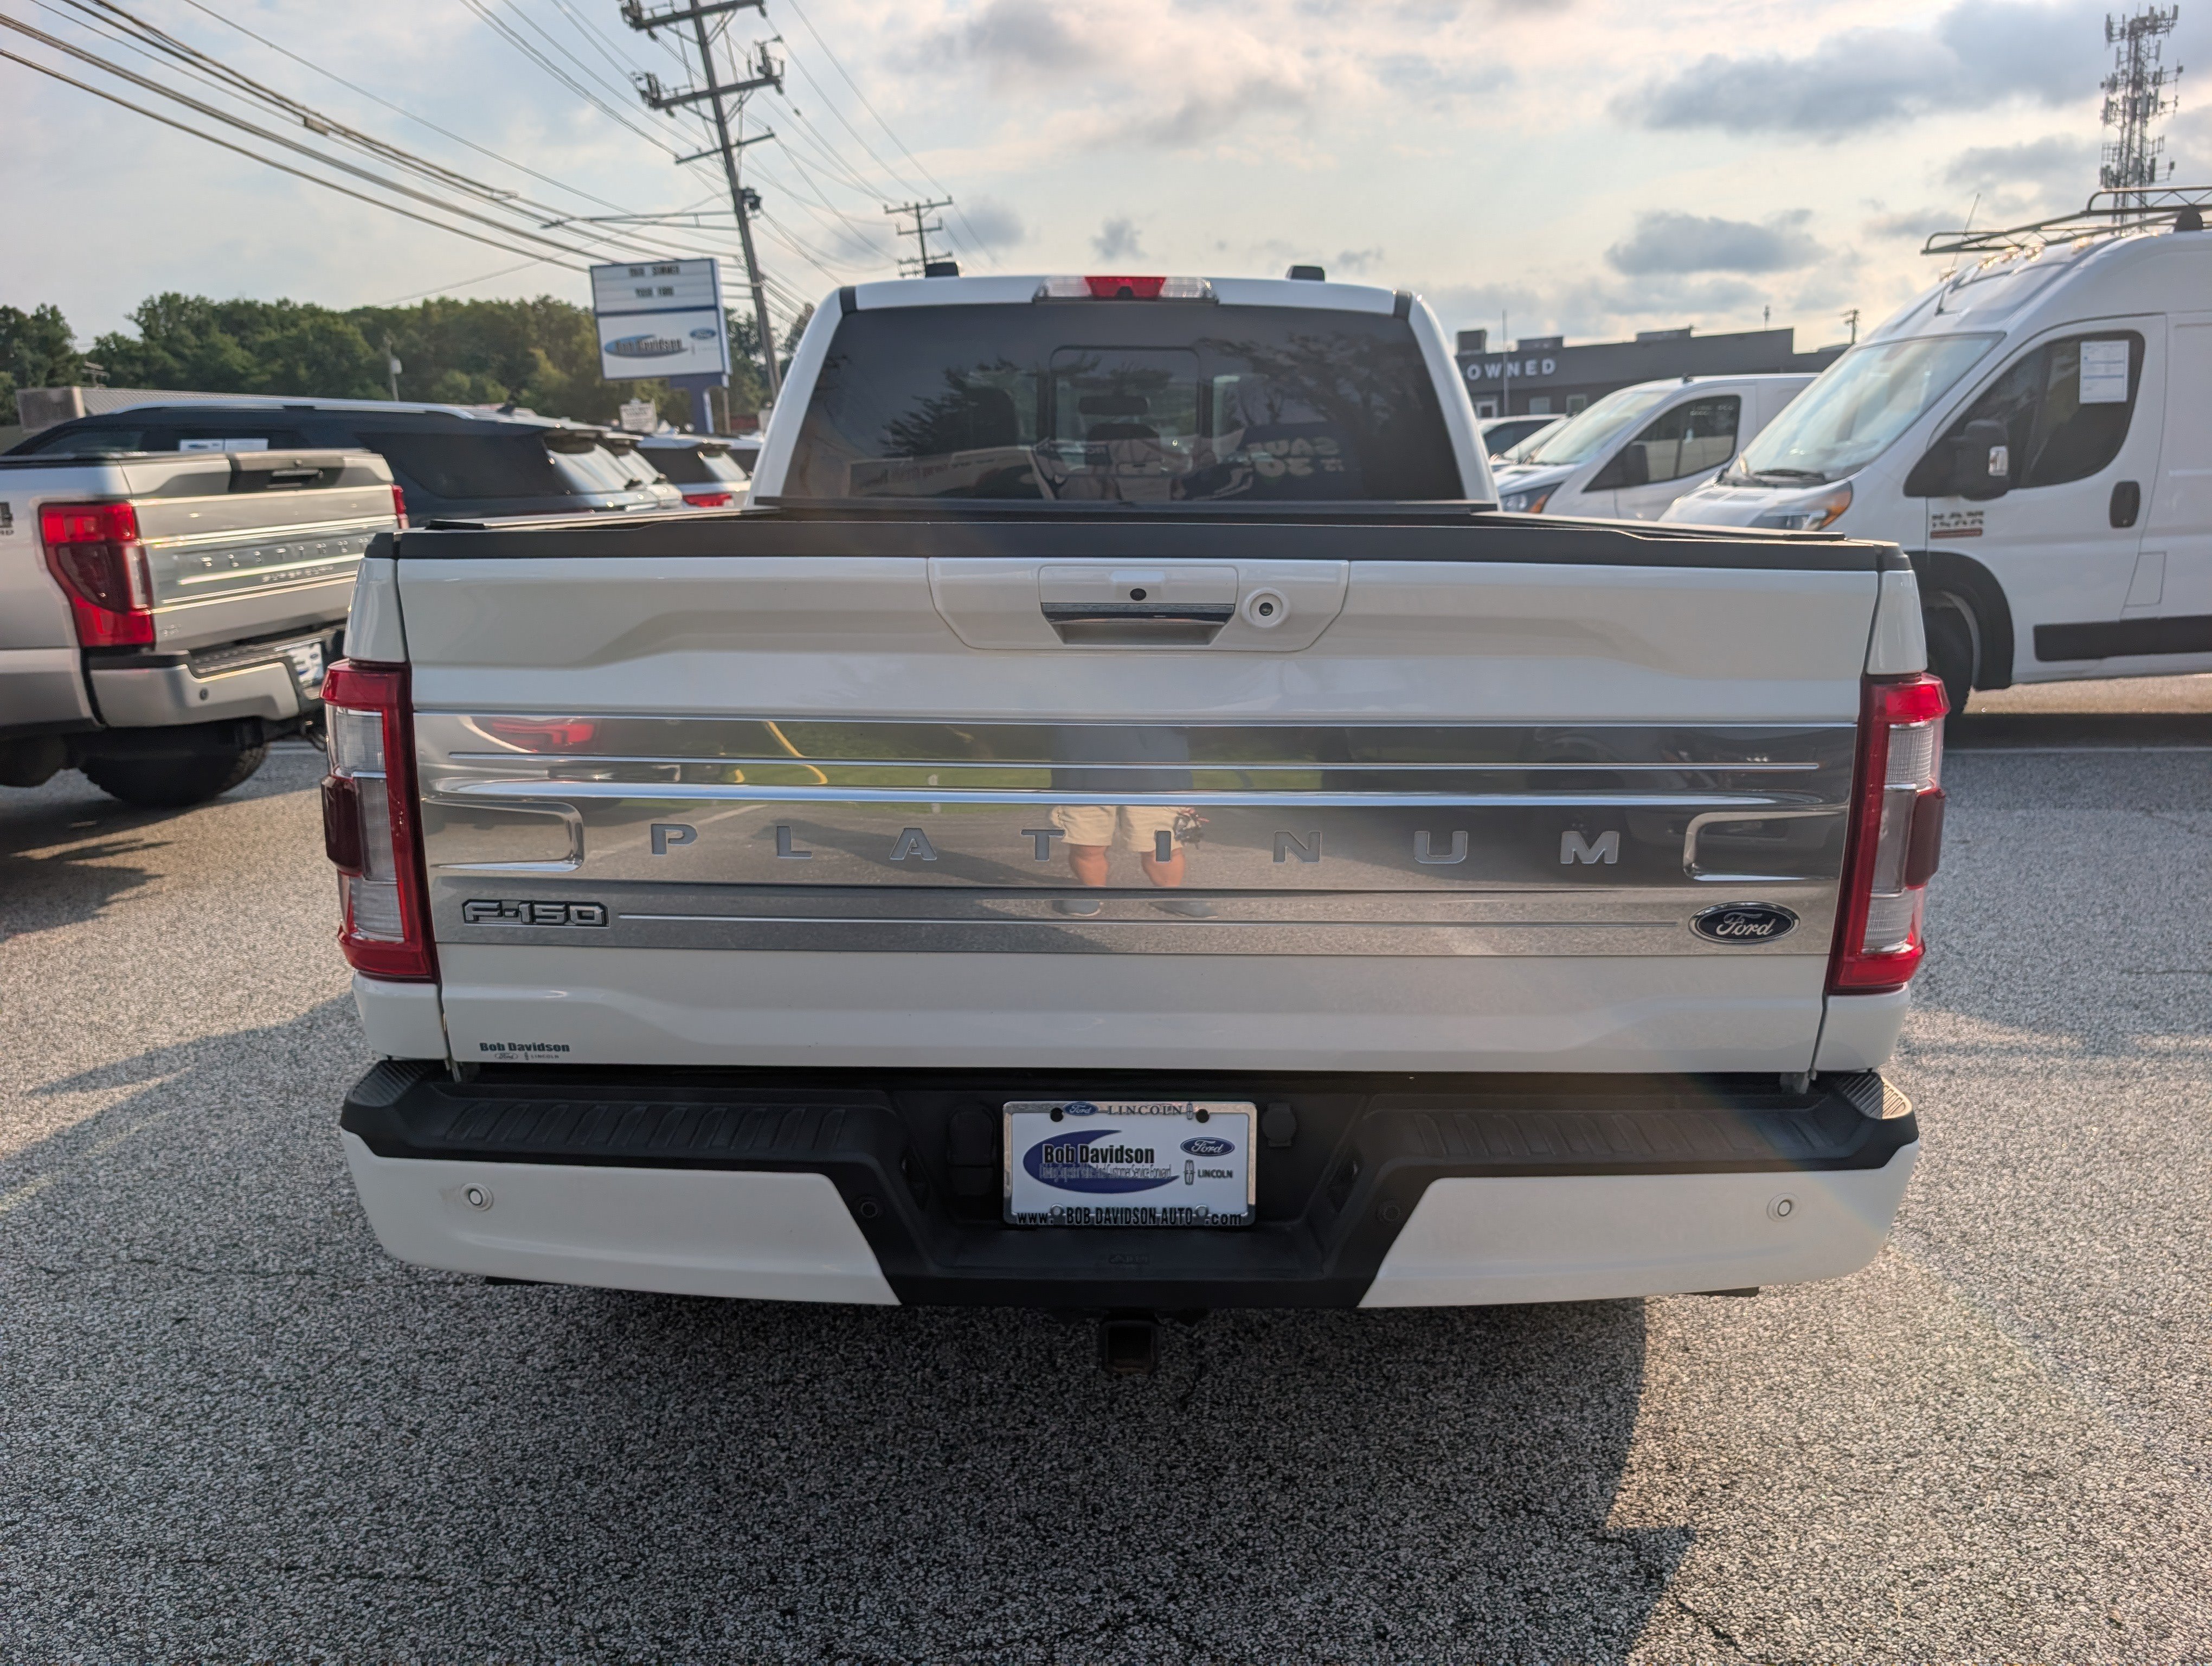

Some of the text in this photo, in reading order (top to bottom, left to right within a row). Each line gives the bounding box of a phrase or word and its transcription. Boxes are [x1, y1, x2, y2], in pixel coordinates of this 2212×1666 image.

[1467, 358, 1555, 380] OWNED
[651, 823, 1620, 865] PLATINUM
[462, 899, 610, 927] F-150
[1715, 912, 1776, 935] Ford
[479, 1042, 570, 1052] Bob Davidson
[1108, 1105, 1182, 1115] LINCOLN
[1043, 1144, 1155, 1164] Bob Davidson
[1191, 1140, 1224, 1153] Ford
[1197, 1169, 1233, 1178] LINCOLN
